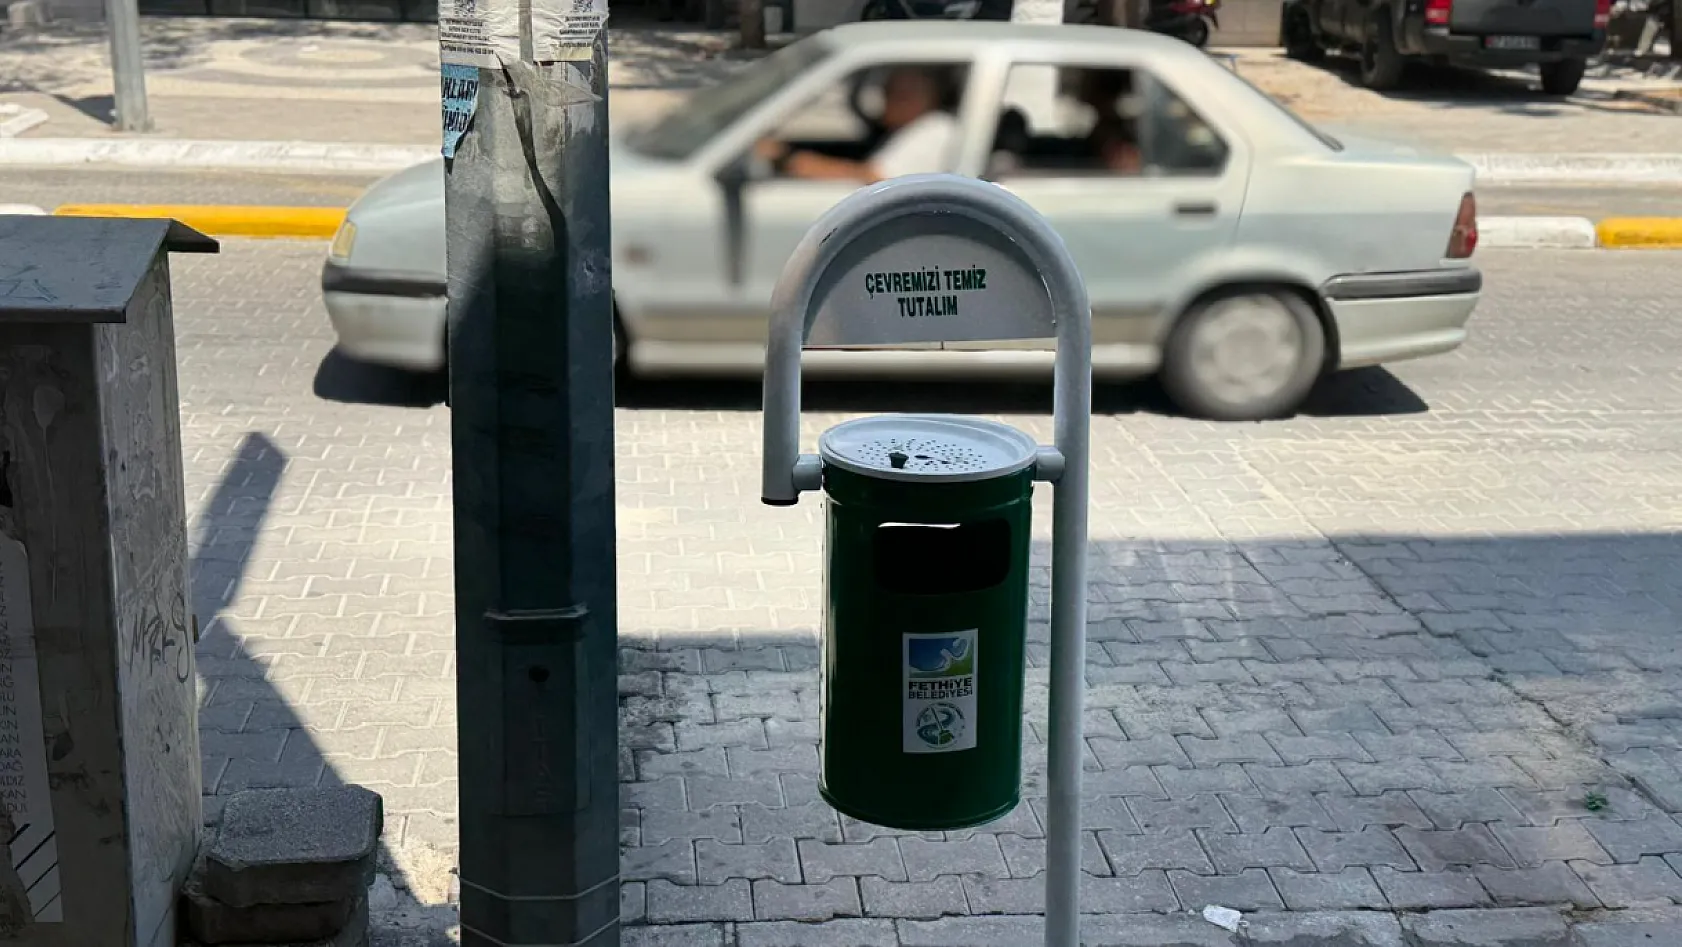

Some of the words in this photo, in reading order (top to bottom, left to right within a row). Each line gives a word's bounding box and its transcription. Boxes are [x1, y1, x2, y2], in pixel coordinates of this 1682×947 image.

[865, 265, 941, 300] ÇEVREMİZİ
[943, 264, 987, 291] TEMİZ
[898, 295, 958, 317] TUTALIM
[908, 677, 973, 691] FETHİYE
